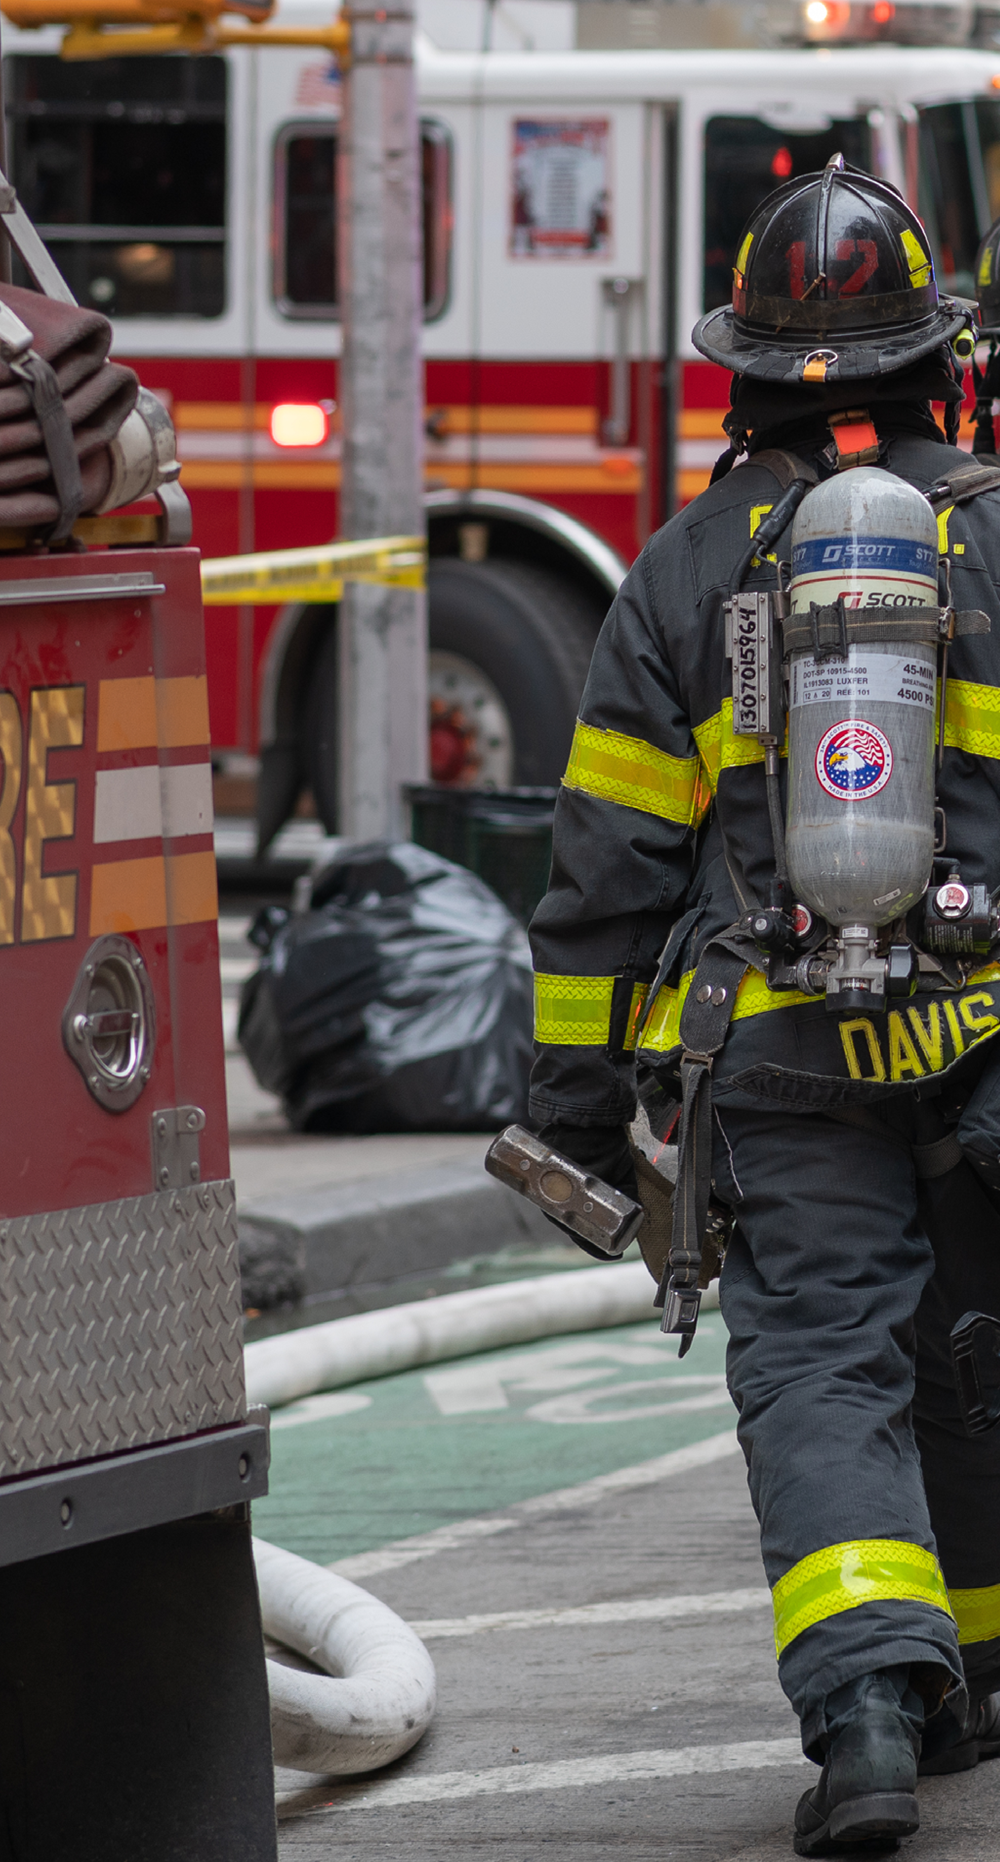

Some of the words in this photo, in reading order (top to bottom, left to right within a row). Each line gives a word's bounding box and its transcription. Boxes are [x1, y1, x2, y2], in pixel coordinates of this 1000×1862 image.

[785, 239, 878, 299] 12
[844, 545, 895, 556] SCOTT
[916, 547, 934, 563] ST7
[866, 592, 926, 607] SCOTT
[739, 607, 757, 729] 1307015964
[803, 669, 826, 679] DOT-SP
[827, 667, 868, 675] 10915-4500
[903, 664, 934, 680] 45-MIN
[822, 690, 831, 698] 20
[897, 688, 923, 702] 4500
[872, 729, 887, 748] SAFETY
[828, 785, 844, 796] MADE
[838, 990, 1000, 1082] DAVIS
